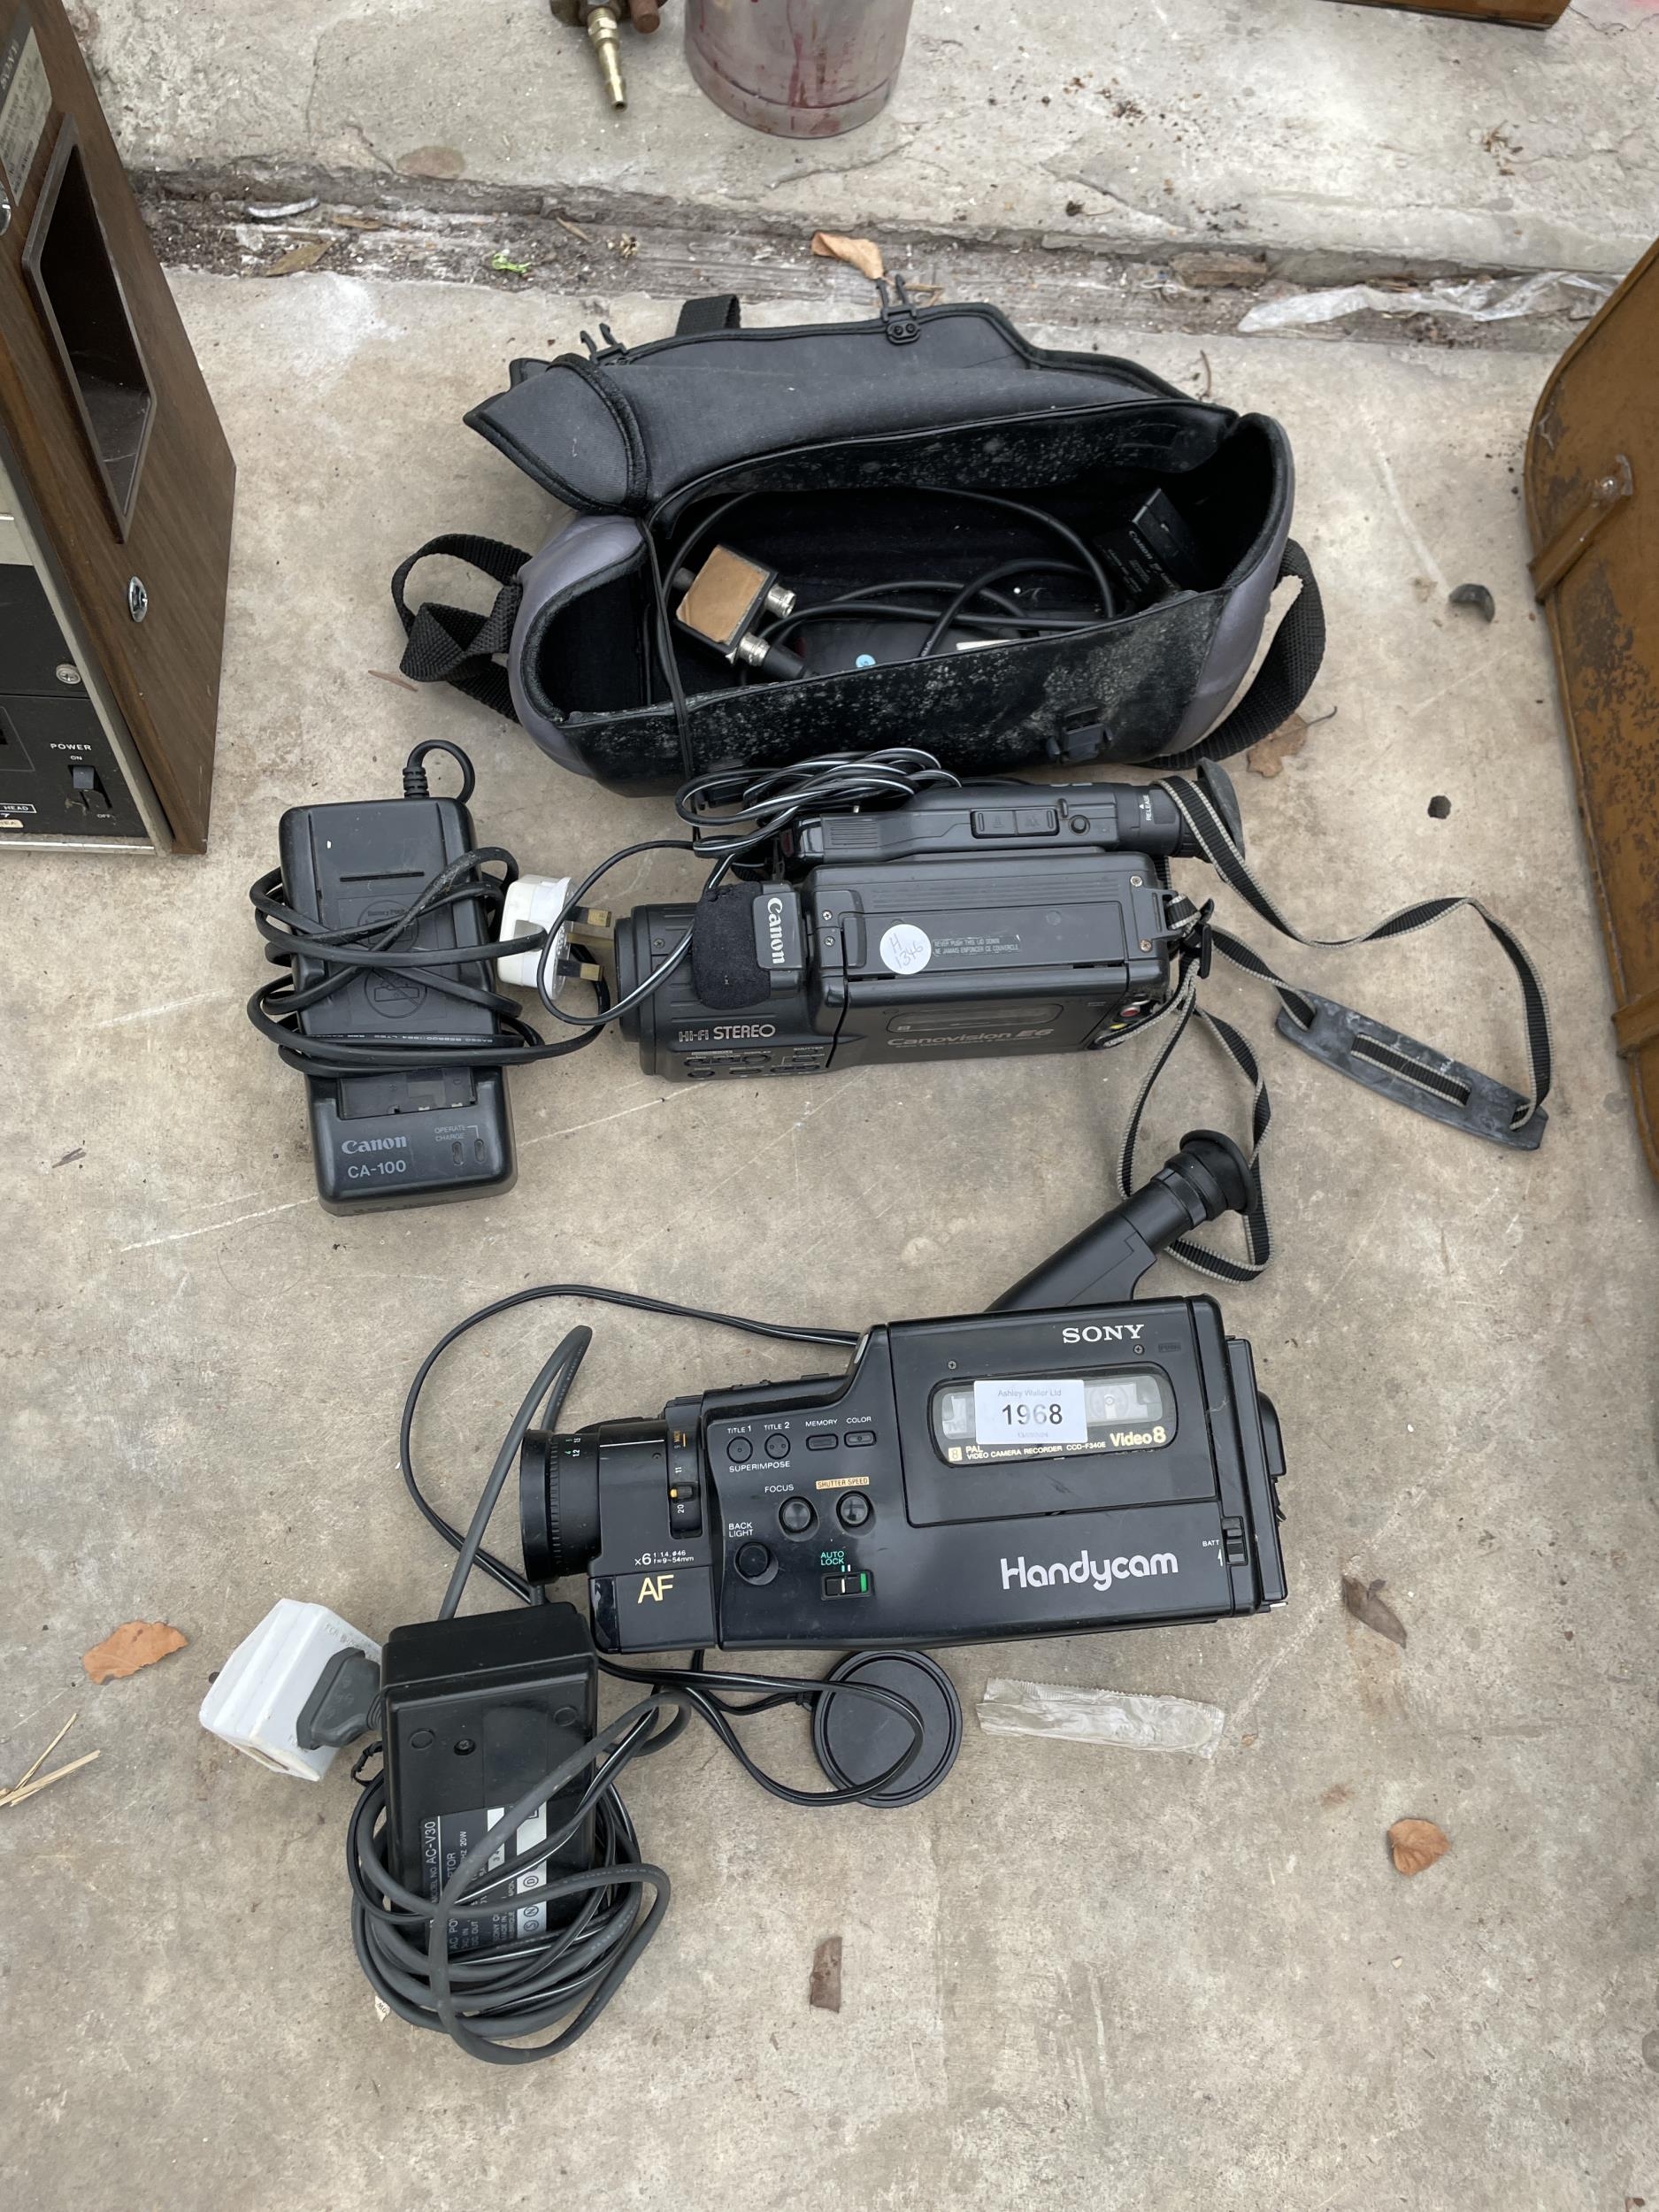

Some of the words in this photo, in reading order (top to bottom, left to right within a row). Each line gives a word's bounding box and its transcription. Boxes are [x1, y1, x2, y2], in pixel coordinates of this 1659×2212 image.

[1142, 795, 1152, 821] RELEASE
[767, 897, 785, 964] Canon
[889, 933, 902, 954] H
[713, 1024, 776, 1040] STEREO
[887, 1033, 1011, 1046] Canovision
[1016, 1028, 1055, 1037] E6
[434, 1125, 466, 1134] OPERATE
[435, 1133, 465, 1142] CHARGE
[342, 1136, 408, 1155] Canon
[347, 1160, 407, 1179] CA-100
[1062, 1324, 1145, 1344] SONY
[998, 1389, 1023, 1398] Ashley
[1002, 1403, 1063, 1425] 1968
[805, 1418, 838, 1427] MEMORY
[965, 1445, 983, 1454] PAL
[990, 1449, 1022, 1458] CAMERA
[1024, 1445, 1063, 1455] RECORDER
[1066, 1441, 1106, 1451] CCD-F340E
[729, 1461, 791, 1473] SUPERIMPOSE
[764, 1484, 795, 1494] FOCUS
[818, 1479, 847, 1488] SHUTTER
[848, 1477, 868, 1486] SPEED
[677, 1503, 685, 1514] 20
[728, 1522, 753, 1531] BACK
[728, 1529, 753, 1538] LIGHT
[1000, 1549, 1179, 1592] Handycam
[637, 1574, 674, 1604] AF
[424, 1821, 437, 1864] AC-V30
